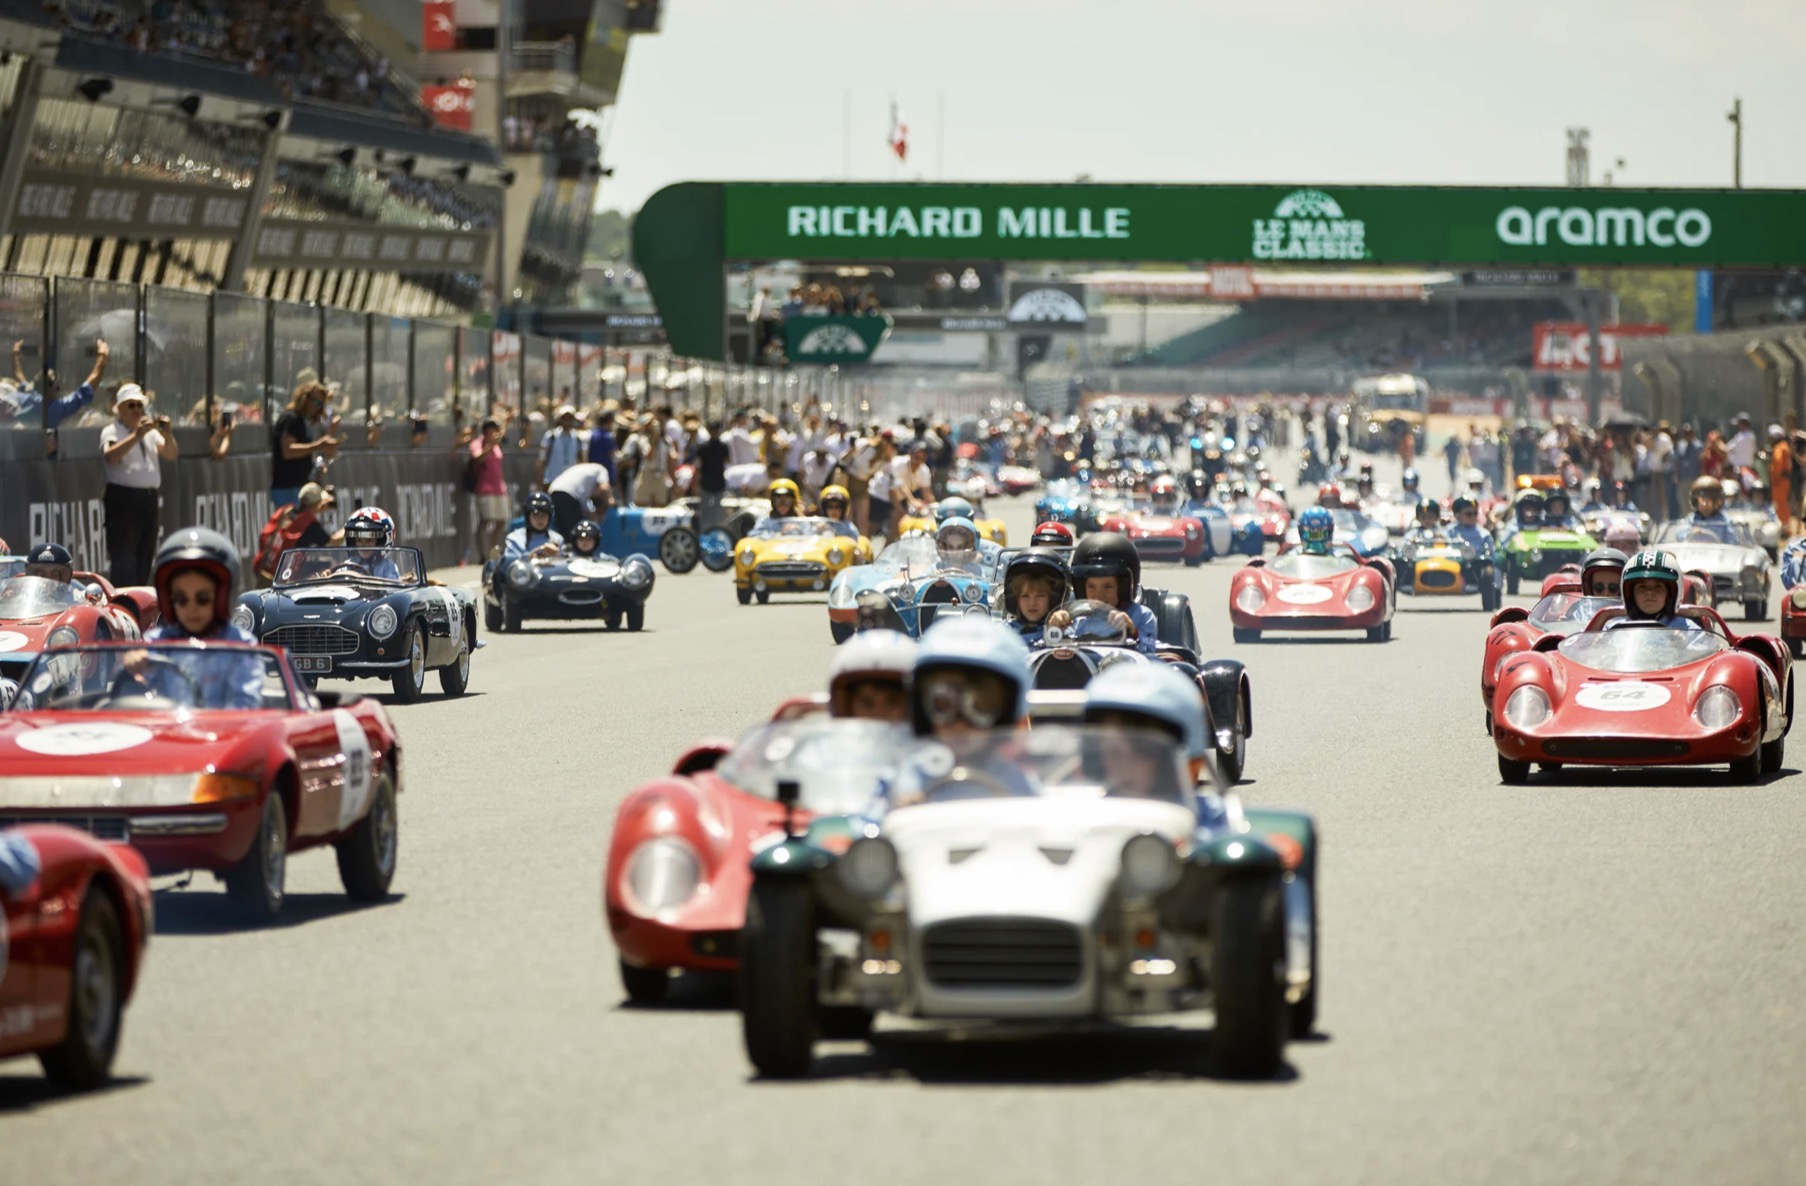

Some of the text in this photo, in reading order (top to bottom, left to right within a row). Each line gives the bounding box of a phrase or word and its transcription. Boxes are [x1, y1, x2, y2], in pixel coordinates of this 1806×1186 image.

[788, 206, 1131, 238] RICHARD MILLE
[1253, 219, 1365, 242] LE MANS
[1496, 206, 1712, 247] aramco
[1252, 241, 1365, 260] CLASSIC
[294, 658, 325, 670] GB 6
[1599, 690, 1647, 701] 64
